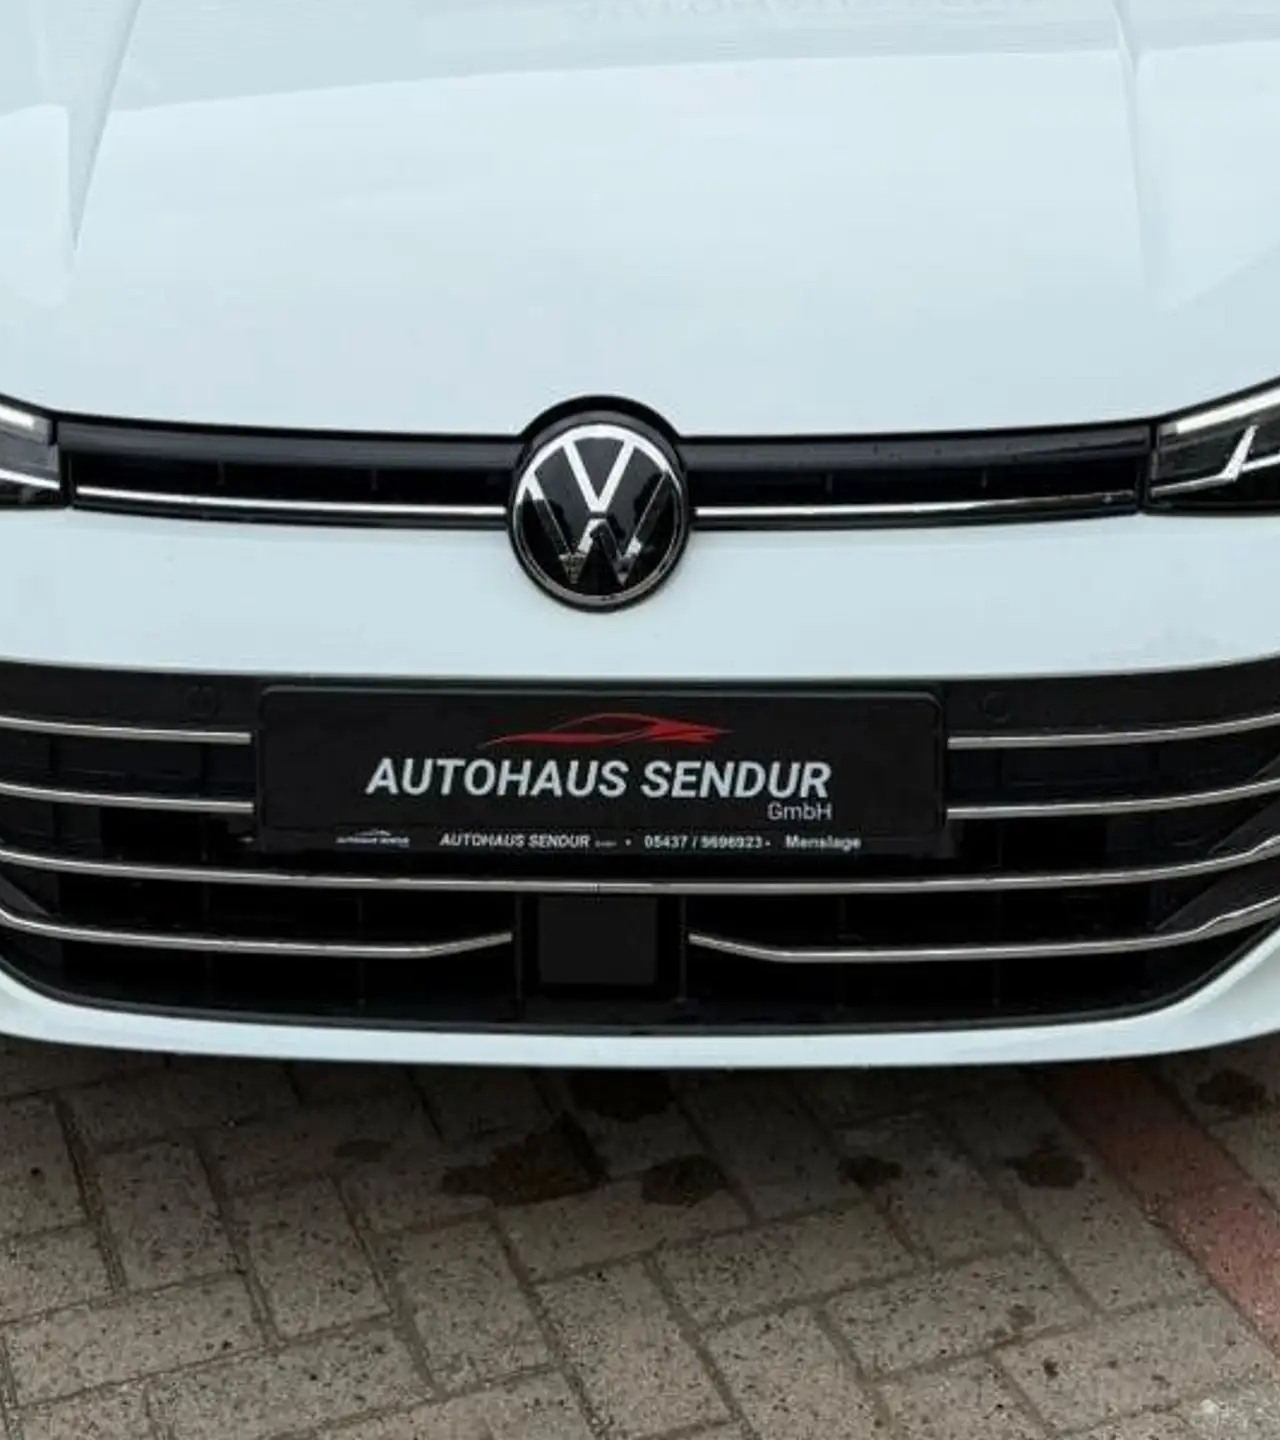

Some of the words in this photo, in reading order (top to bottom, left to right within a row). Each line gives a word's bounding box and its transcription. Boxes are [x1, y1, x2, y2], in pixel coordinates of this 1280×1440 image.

[365, 757, 630, 798] AUTOHAUS
[639, 759, 832, 799] SENDUR
[766, 802, 832, 821] GmbH
[439, 833, 524, 848] AUTOHAUS
[528, 834, 592, 849] SENDUR
[785, 835, 862, 851] Menslage
